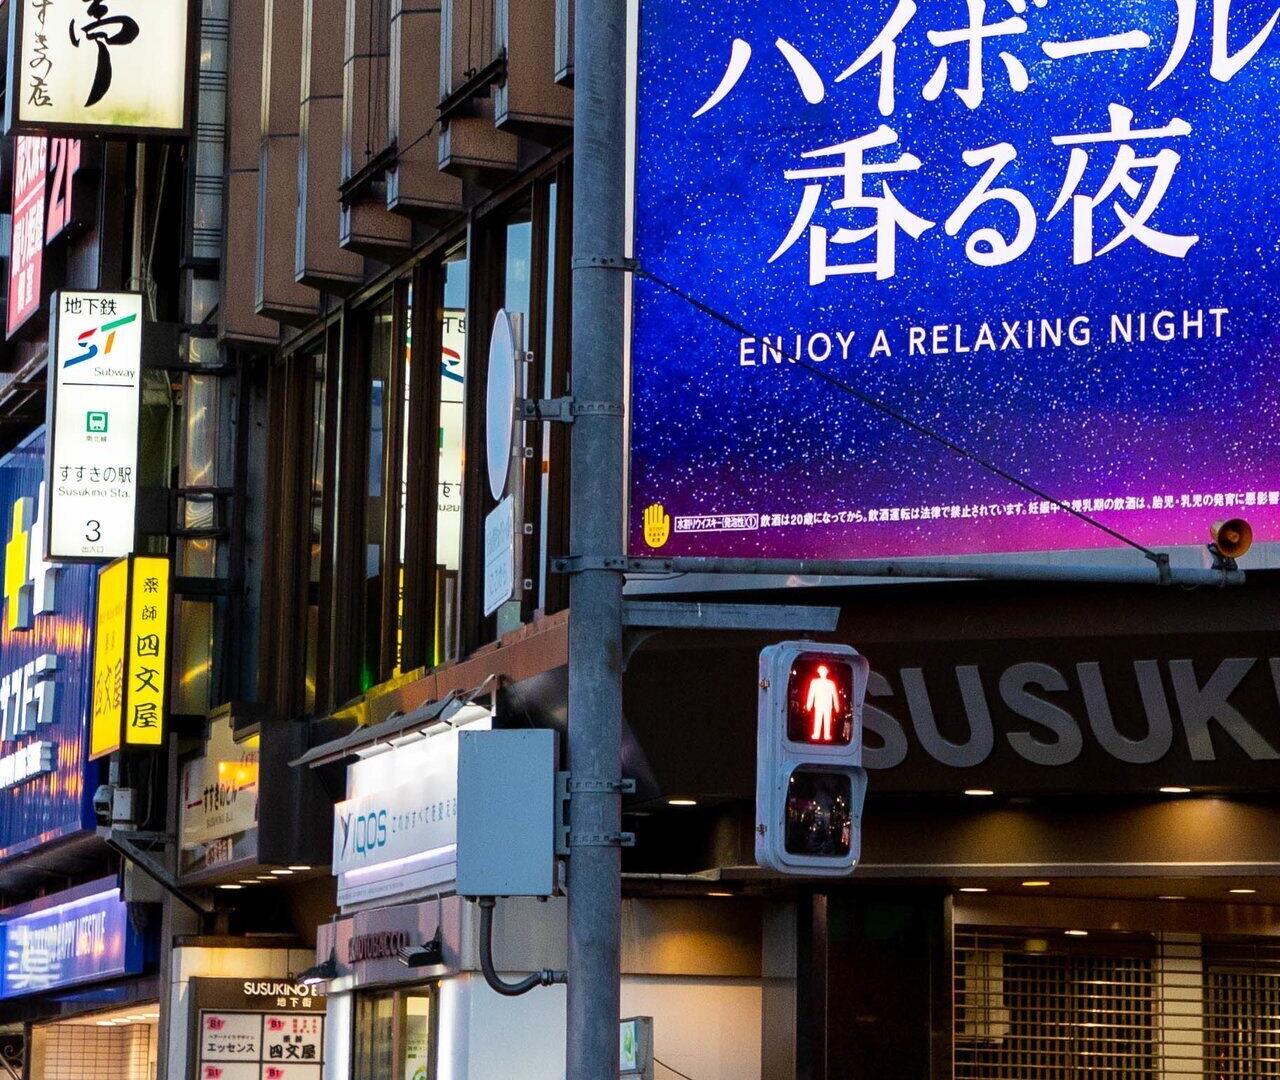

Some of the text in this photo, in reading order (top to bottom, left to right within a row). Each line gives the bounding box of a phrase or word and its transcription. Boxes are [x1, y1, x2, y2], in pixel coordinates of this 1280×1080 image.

[767, 103, 1200, 286] 香る夜
[65, 297, 117, 315] 地下鉄
[739, 307, 1229, 367] ENJOY A RELAXING NIGHT
[94, 367, 135, 378] Subway
[59, 466, 131, 483] すすきの駅
[58, 487, 130, 498] Susukino Sta.
[85, 520, 102, 542] 3
[132, 633, 160, 728] 四文屋
[243, 981, 309, 996] SUSUKINO
[277, 997, 312, 1008] 地下街
[207, 1043, 256, 1053] エッセンス
[269, 1043, 316, 1059] 四文屋
